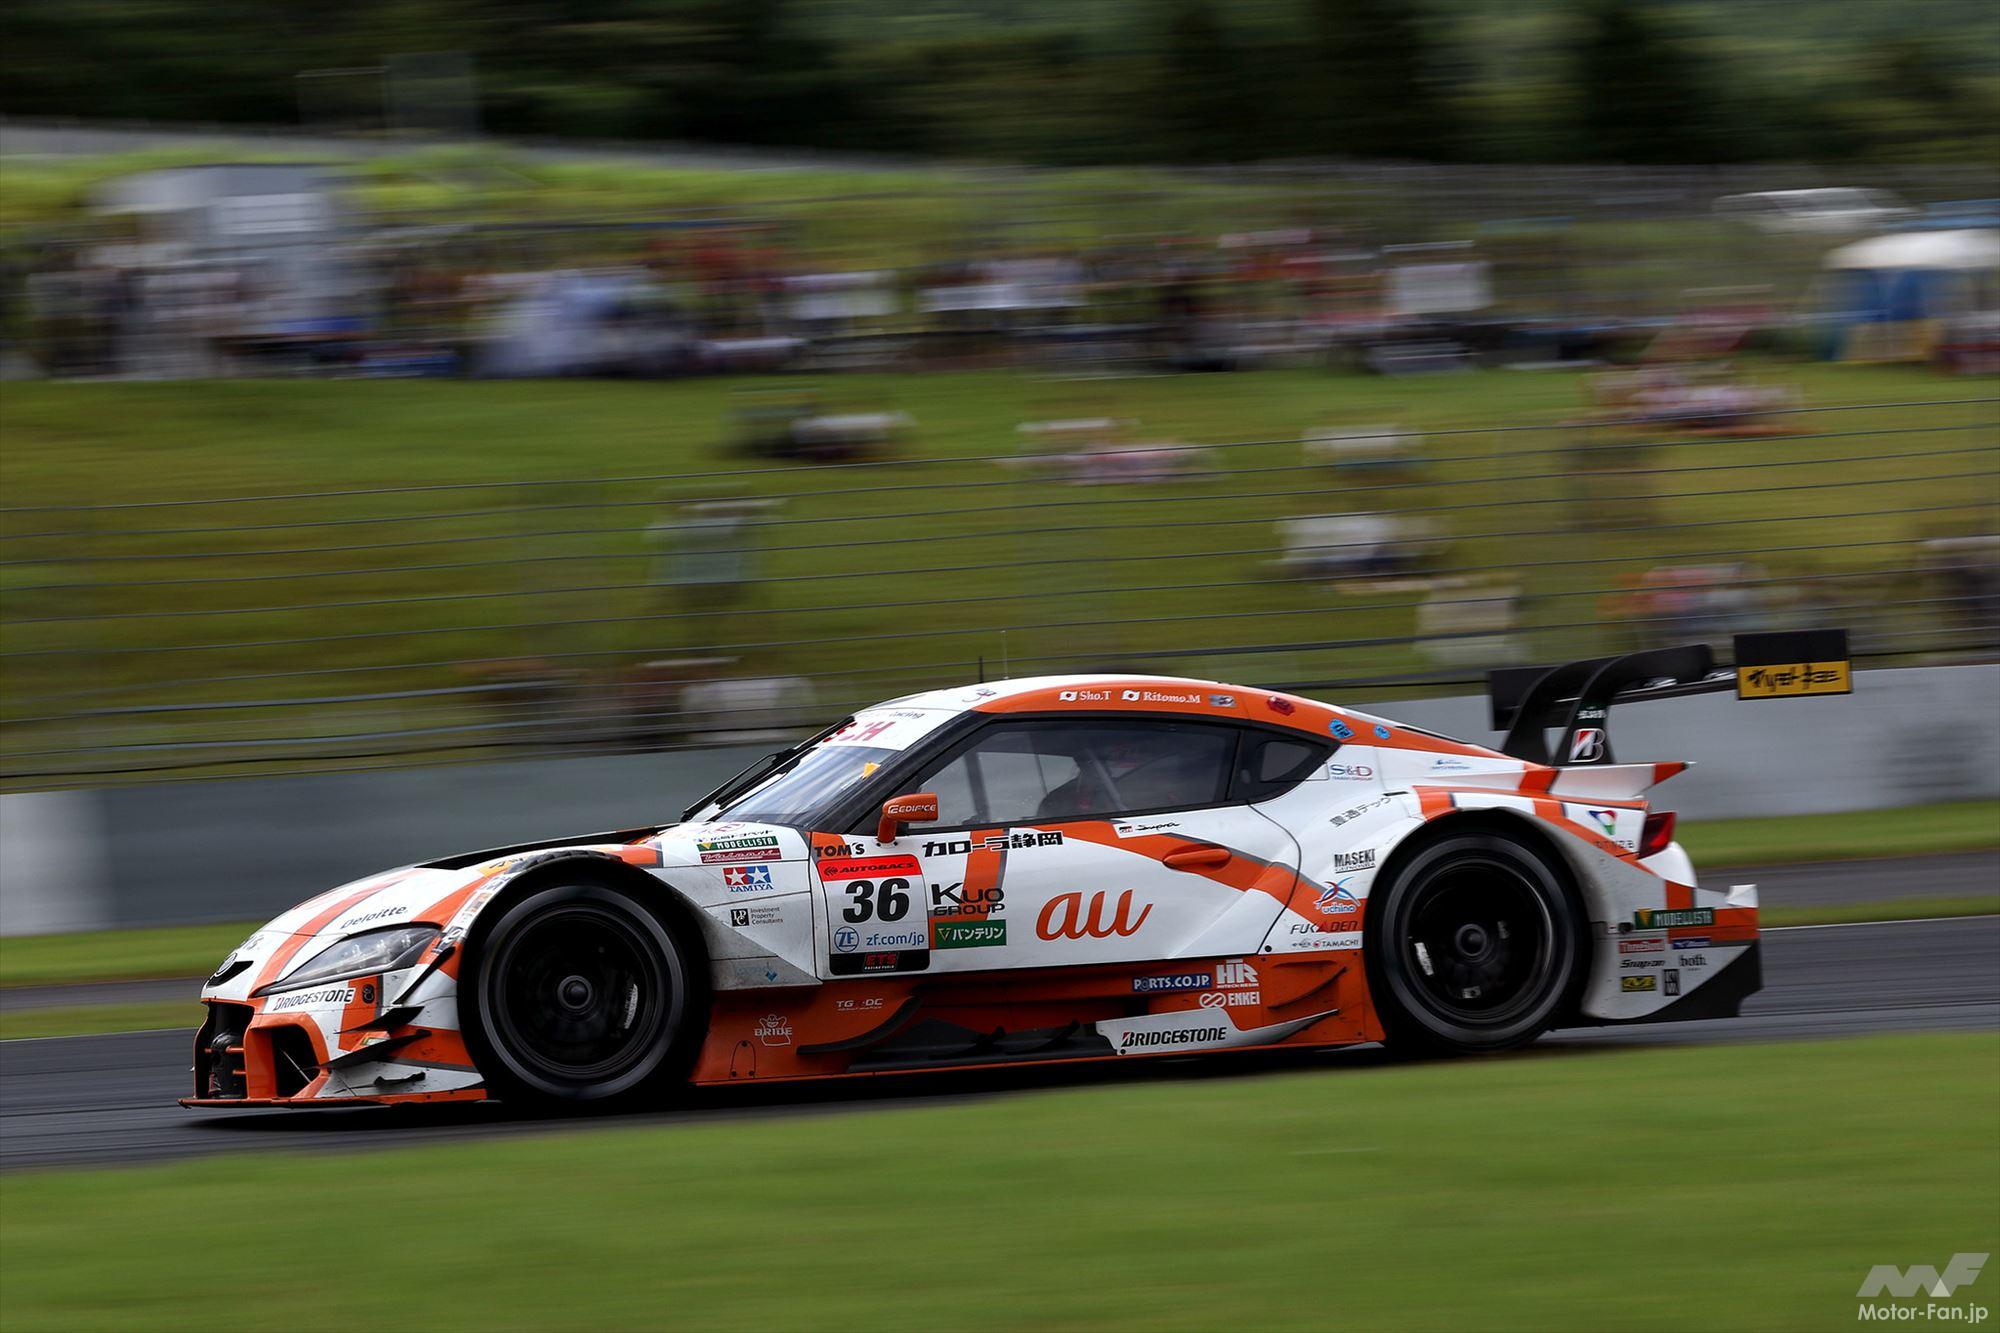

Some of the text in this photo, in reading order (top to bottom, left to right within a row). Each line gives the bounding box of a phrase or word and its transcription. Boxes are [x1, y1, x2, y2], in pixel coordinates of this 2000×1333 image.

[1080, 690, 1112, 701] Sho.T
[1143, 692, 1201, 704] Ritomo.M
[1330, 763, 1373, 777] S&D
[716, 837, 774, 850] MODELLISTA
[814, 841, 866, 858] TOM'S
[922, 831, 1065, 858] カローラ静岡
[1334, 848, 1376, 868] MASEKI
[839, 861, 915, 874] AUTOBACS
[728, 882, 775, 894] TAMIYA
[842, 877, 911, 924] 36
[750, 906, 781, 914] Investment
[751, 912, 775, 921] Property
[933, 903, 1006, 917] GROUP
[1036, 888, 1154, 942] au
[751, 917, 784, 926] Consultants
[1655, 910, 1713, 927] MODELLISTA
[837, 931, 856, 946] ZF
[866, 931, 925, 946] zf.com/jp
[952, 926, 1004, 941] バンテリン
[1322, 938, 1359, 948] TAMACHI
[273, 987, 356, 1011] BRIDGESTONE
[1228, 991, 1261, 1006] ENKEI
[754, 1026, 793, 1037] BRIDE
[1121, 1026, 1227, 1048] BRIDGESTONE
